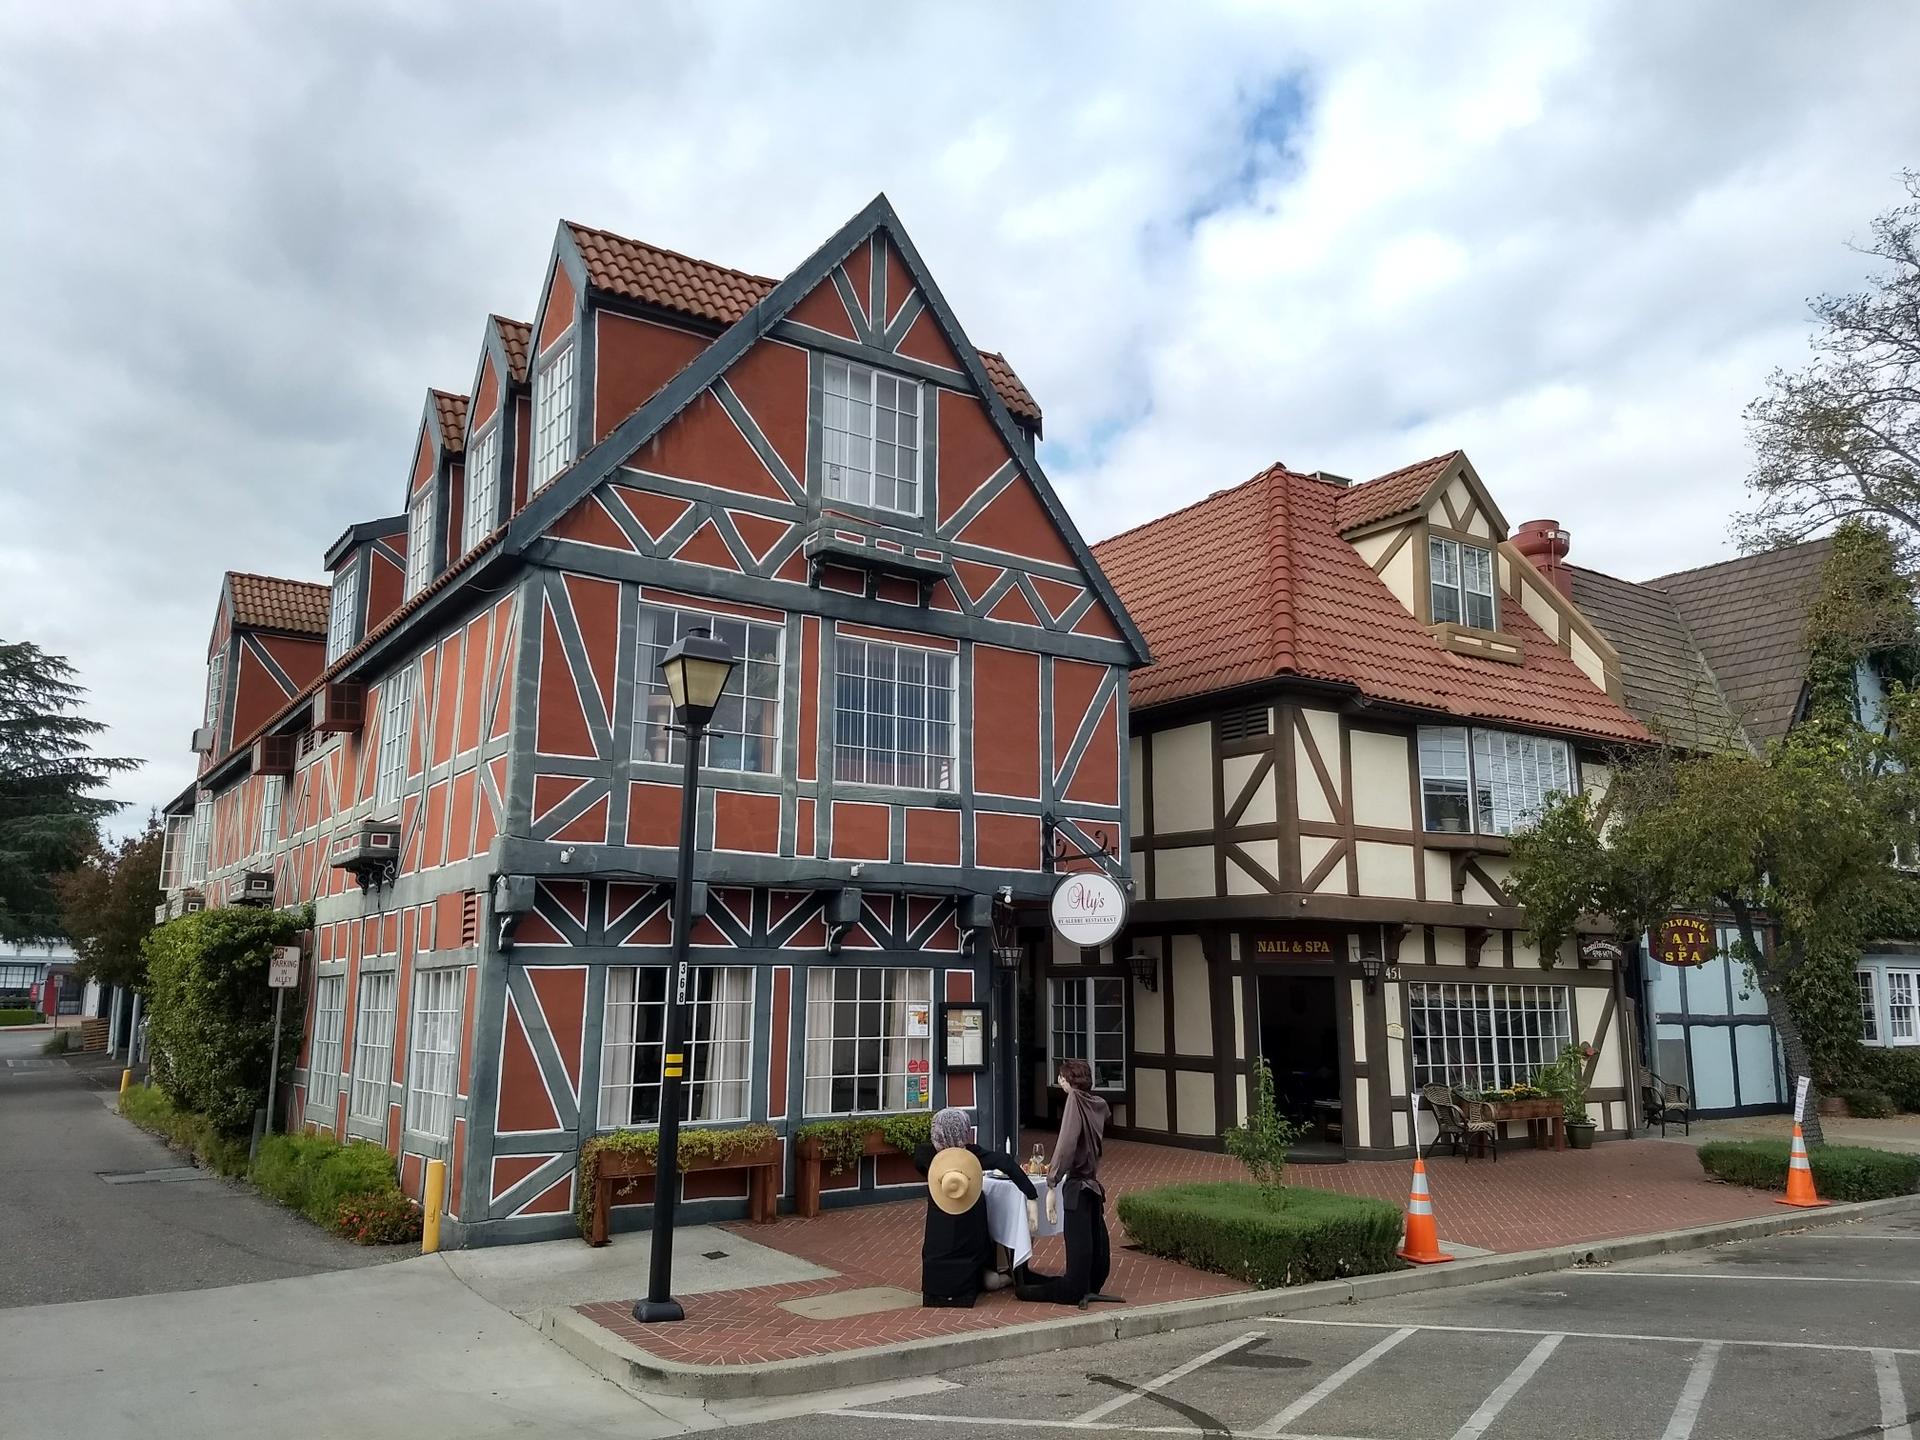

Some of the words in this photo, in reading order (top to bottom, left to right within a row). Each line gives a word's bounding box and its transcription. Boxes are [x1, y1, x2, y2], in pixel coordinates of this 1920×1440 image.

[1067, 882, 1105, 915] Aly's
[1657, 919, 1706, 932] OLVANG
[1257, 941, 1290, 953] NAIL
[1292, 941, 1302, 953] &
[1305, 941, 1330, 953] SPA
[1665, 951, 1701, 962] SPA
[272, 960, 298, 968] PARKING
[1385, 967, 1401, 979] 451
